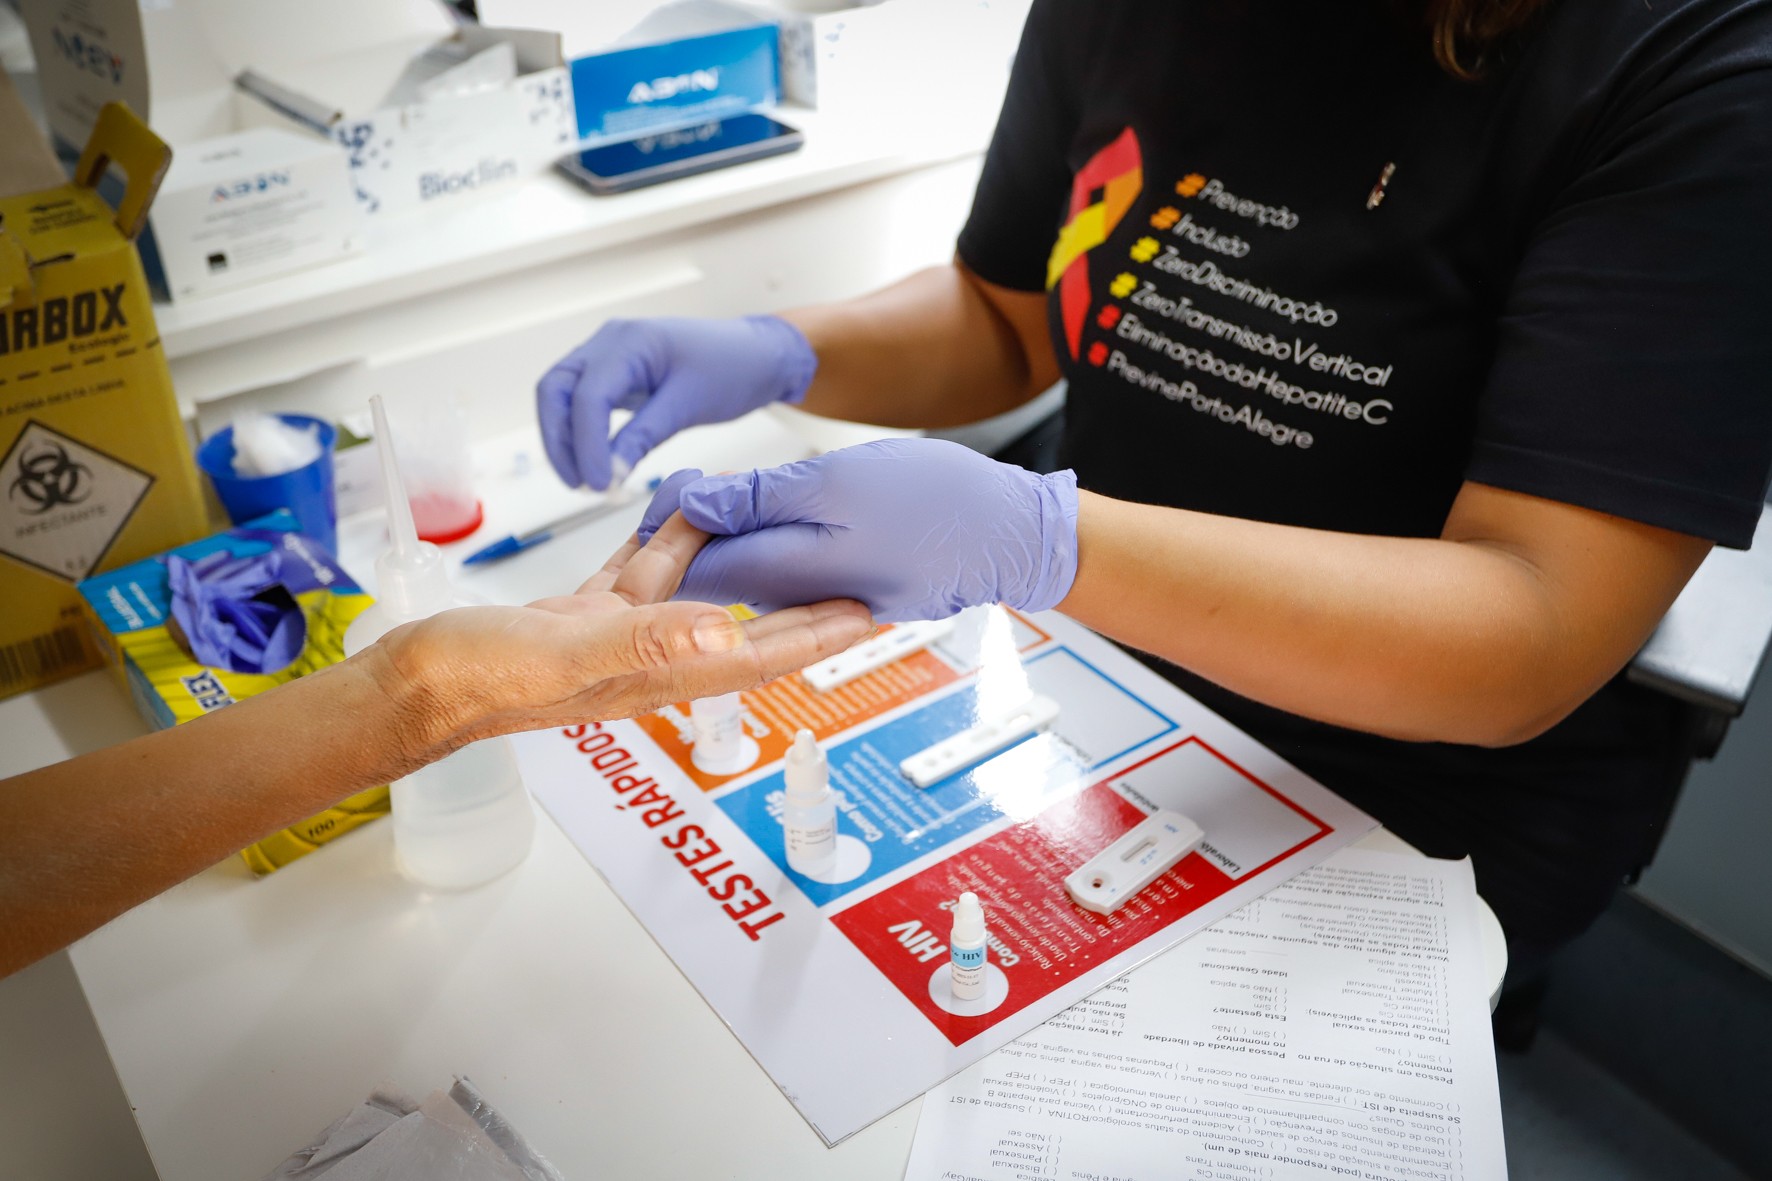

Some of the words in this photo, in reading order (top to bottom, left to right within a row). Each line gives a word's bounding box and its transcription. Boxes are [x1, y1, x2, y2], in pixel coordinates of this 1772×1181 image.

[562, 721, 686, 829] RÁPIDOS
[661, 823, 785, 942] TESTES
[1093, 923, 1111, 936] Da
[887, 919, 948, 963] HIV
[1036, 934, 1053, 947] de
[1016, 936, 1054, 970] Relação
[1046, 943, 1068, 961] Uso
[1261, 968, 1287, 977] Idade
[1083, 997, 1126, 1009] pergunta
[1252, 993, 1271, 1002] Não
[1112, 1011, 1125, 1019] Se
[1213, 1004, 1261, 1018] gestante?
[1264, 1012, 1285, 1021] Esta
[1048, 1020, 1085, 1031] relação
[1211, 1024, 1230, 1033] Não
[1332, 1021, 1364, 1032] sexual
[1379, 1018, 1408, 1029] todas
[1411, 1023, 1450, 1035] (marcar
[1088, 1026, 1108, 1034] teve
[1252, 1029, 1270, 1038] Sim
[1368, 1025, 1409, 1038] parceria
[1143, 1033, 1189, 1046] liberdade
[1192, 1040, 1204, 1048] de
[1216, 1033, 1269, 1047] momento?
[1428, 1034, 1450, 1045] Tipo
[1208, 1040, 1245, 1053] privada
[1039, 1052, 1065, 1064] pênis
[1092, 1051, 1122, 1062] bolhas
[1248, 1047, 1284, 1059] Pessoa
[1297, 1053, 1310, 1061] no
[1314, 1055, 1330, 1063] rua
[1125, 1055, 1172, 1069] Pequenas
[1334, 1058, 1345, 1066] de
[1349, 1060, 1392, 1074] situação
[1397, 1059, 1452, 1073] momento?
[1005, 1070, 1030, 1080] PrEP
[1119, 1064, 1161, 1078] Verrugas
[1197, 1066, 1231, 1077] coceira
[1396, 1068, 1411, 1077] em
[981, 1077, 1013, 1089] sexual
[1048, 1077, 1070, 1086] PEP
[1180, 1074, 1203, 1085] ânus
[1250, 1073, 1279, 1084] cheiro
[1283, 1077, 1302, 1086] mau
[1415, 1071, 1452, 1084] Pessoa
[1015, 1082, 1059, 1096] Violência
[1089, 1081, 1146, 1098] imunológica
[1221, 1078, 1247, 1091] pênis
[949, 1094, 966, 1104] IST
[996, 1089, 1035, 1103] hepatite
[1081, 1090, 1146, 1109] ONG/projetos
[1148, 1091, 1180, 1103] Janela
[1288, 1089, 1300, 1098] na
[1304, 1091, 1340, 1103] Feridas
[1373, 1091, 1385, 1099] de
[968, 1097, 980, 1106] de
[983, 1098, 1025, 1112] Suspeita
[1038, 1095, 1060, 1105] para
[1062, 1099, 1095, 1111] Vacina
[1203, 1098, 1238, 1110] objetos
[1388, 1093, 1443, 1110] Corrimento
[1149, 1102, 1161, 1111] de
[1241, 1104, 1254, 1112] de
[1383, 1105, 1395, 1113] de
[1047, 1106, 1141, 1130] sorológico/ROTINA
[1114, 1106, 1188, 1125] perfurocortante
[1165, 1104, 1250, 1124] Encaminhamento
[1257, 1105, 1344, 1127] compartilhamento
[1399, 1106, 1443, 1120] suspeita
[1447, 1114, 1460, 1124] Se
[1191, 1118, 1234, 1131] Acidente
[1269, 1118, 1322, 1135] Prevenção
[1347, 1121, 1367, 1130] com
[1369, 1114, 1404, 1127] Quais?
[1007, 1128, 1021, 1137] sei
[1144, 1122, 1173, 1134] status
[1177, 1127, 1189, 1136] do
[1254, 1128, 1283, 1140] saúde
[1326, 1128, 1337, 1136] de
[1372, 1124, 1405, 1138] drogas
[1024, 1131, 1045, 1142] Não
[1192, 1129, 1263, 1148] Conhecimento
[1287, 1133, 1299, 1142] de
[1303, 1135, 1337, 1148] serviço
[1341, 1131, 1382, 1146] Insumos
[1409, 1132, 1421, 1141] de
[1424, 1135, 1444, 1145] Uso
[998, 1137, 1043, 1152] Assexual
[1342, 1142, 1356, 1152] por
[1386, 1141, 1398, 1149] de
[1402, 1143, 1444, 1157] Retirada
[989, 1147, 1041, 1163] Pansexual
[1228, 1147, 1239, 1155] de
[1244, 1149, 1268, 1160] mais
[1296, 1146, 1319, 1156] risco
[1324, 1151, 1335, 1159] de
[991, 1158, 1040, 1174] Bissexual
[1185, 1154, 1212, 1166] Trans
[1273, 1153, 1327, 1169] responder
[1339, 1153, 1380, 1169] situação
[1195, 1168, 1212, 1178] Cis
[1216, 1160, 1256, 1174] Homem
[1331, 1164, 1360, 1177] (pode
[1393, 1164, 1446, 1181] Exposição
